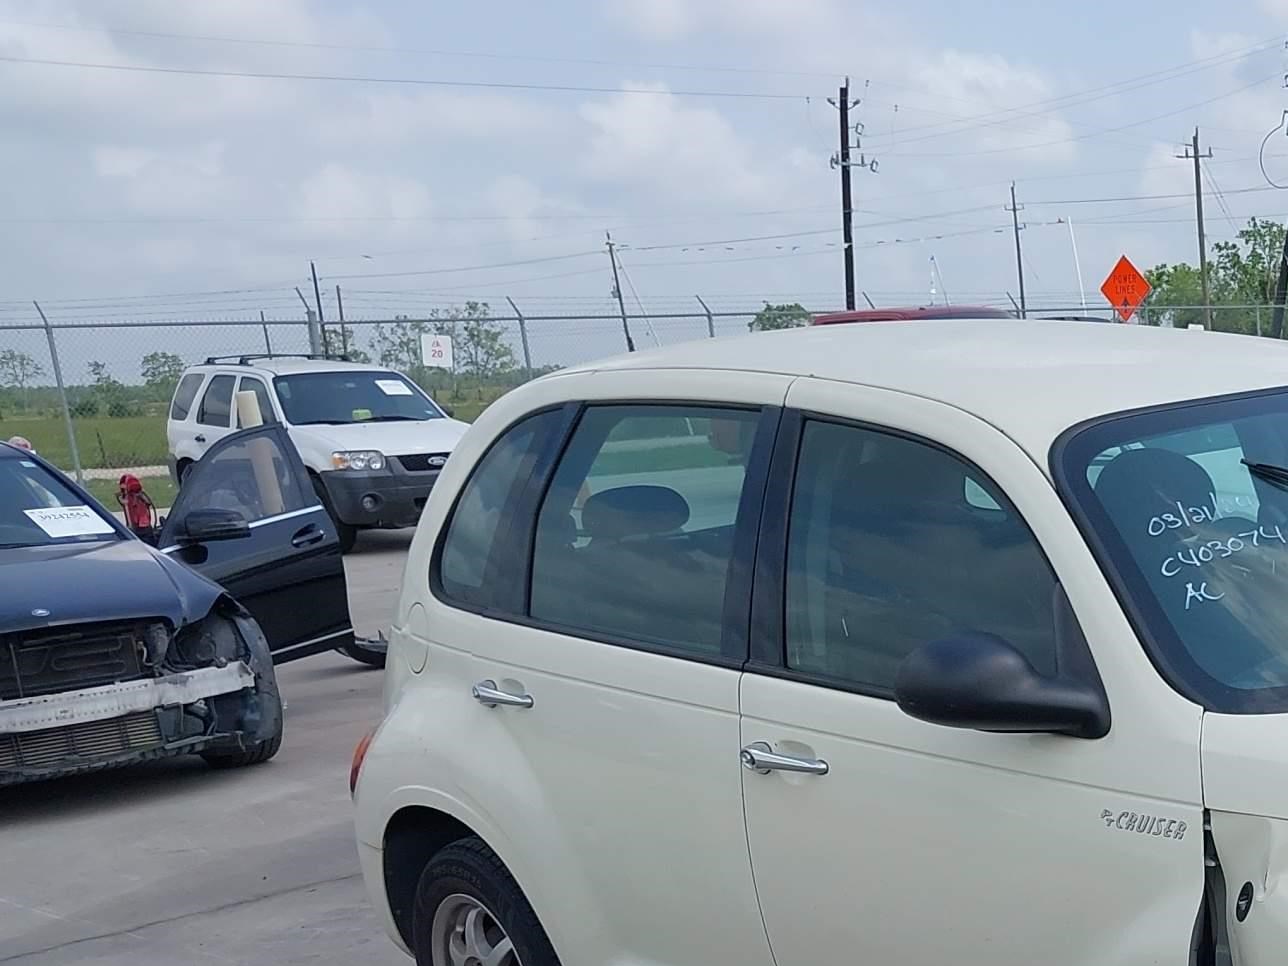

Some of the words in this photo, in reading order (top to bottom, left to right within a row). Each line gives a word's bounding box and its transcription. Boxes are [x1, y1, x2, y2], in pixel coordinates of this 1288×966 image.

[1115, 284, 1136, 295] LINES
[431, 349, 444, 358] 20
[1160, 525, 1287, 577] C403074
[1184, 582, 1226, 610] AC
[1115, 811, 1188, 840] CRUISER
